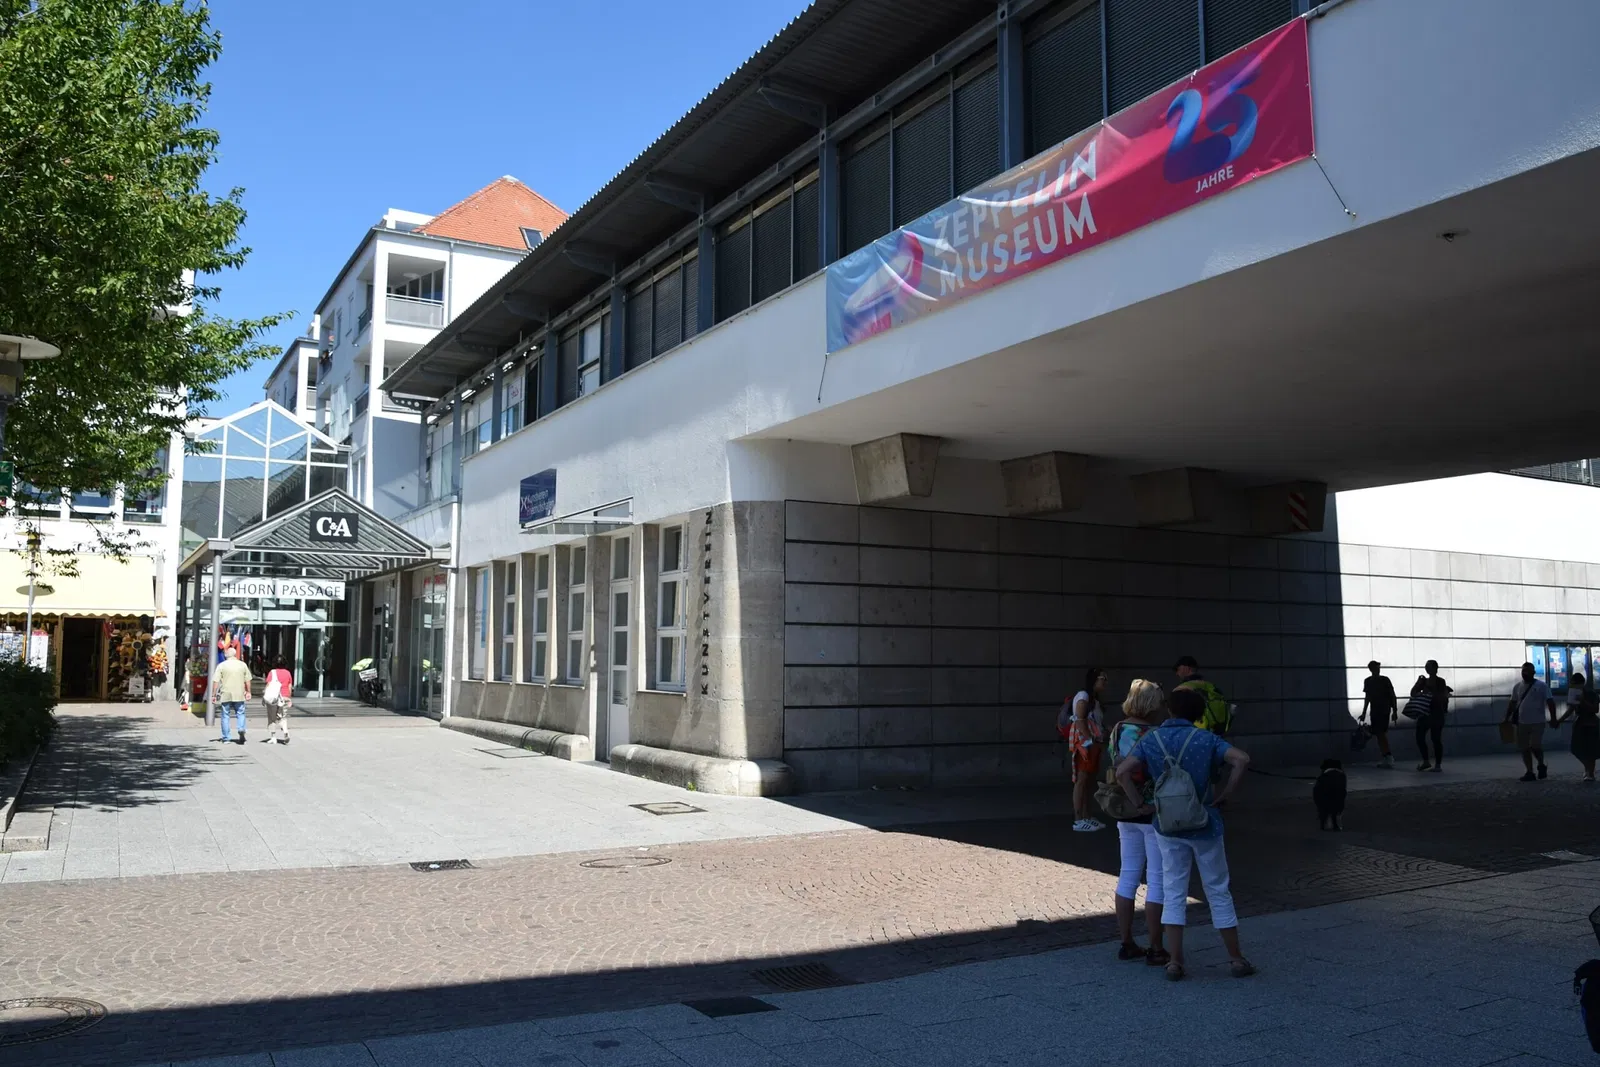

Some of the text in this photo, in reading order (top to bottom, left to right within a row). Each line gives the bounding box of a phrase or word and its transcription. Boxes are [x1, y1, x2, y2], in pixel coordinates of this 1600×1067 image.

[1163, 52, 1262, 184] 25
[934, 139, 1097, 256] ZEPPELIN
[1195, 165, 1235, 193] JAHRE
[940, 191, 1098, 296] MUSEUM
[316, 516, 353, 537] C&A
[282, 584, 341, 597] PASSAGE
[701, 511, 712, 695] KUNSTVEREIN
